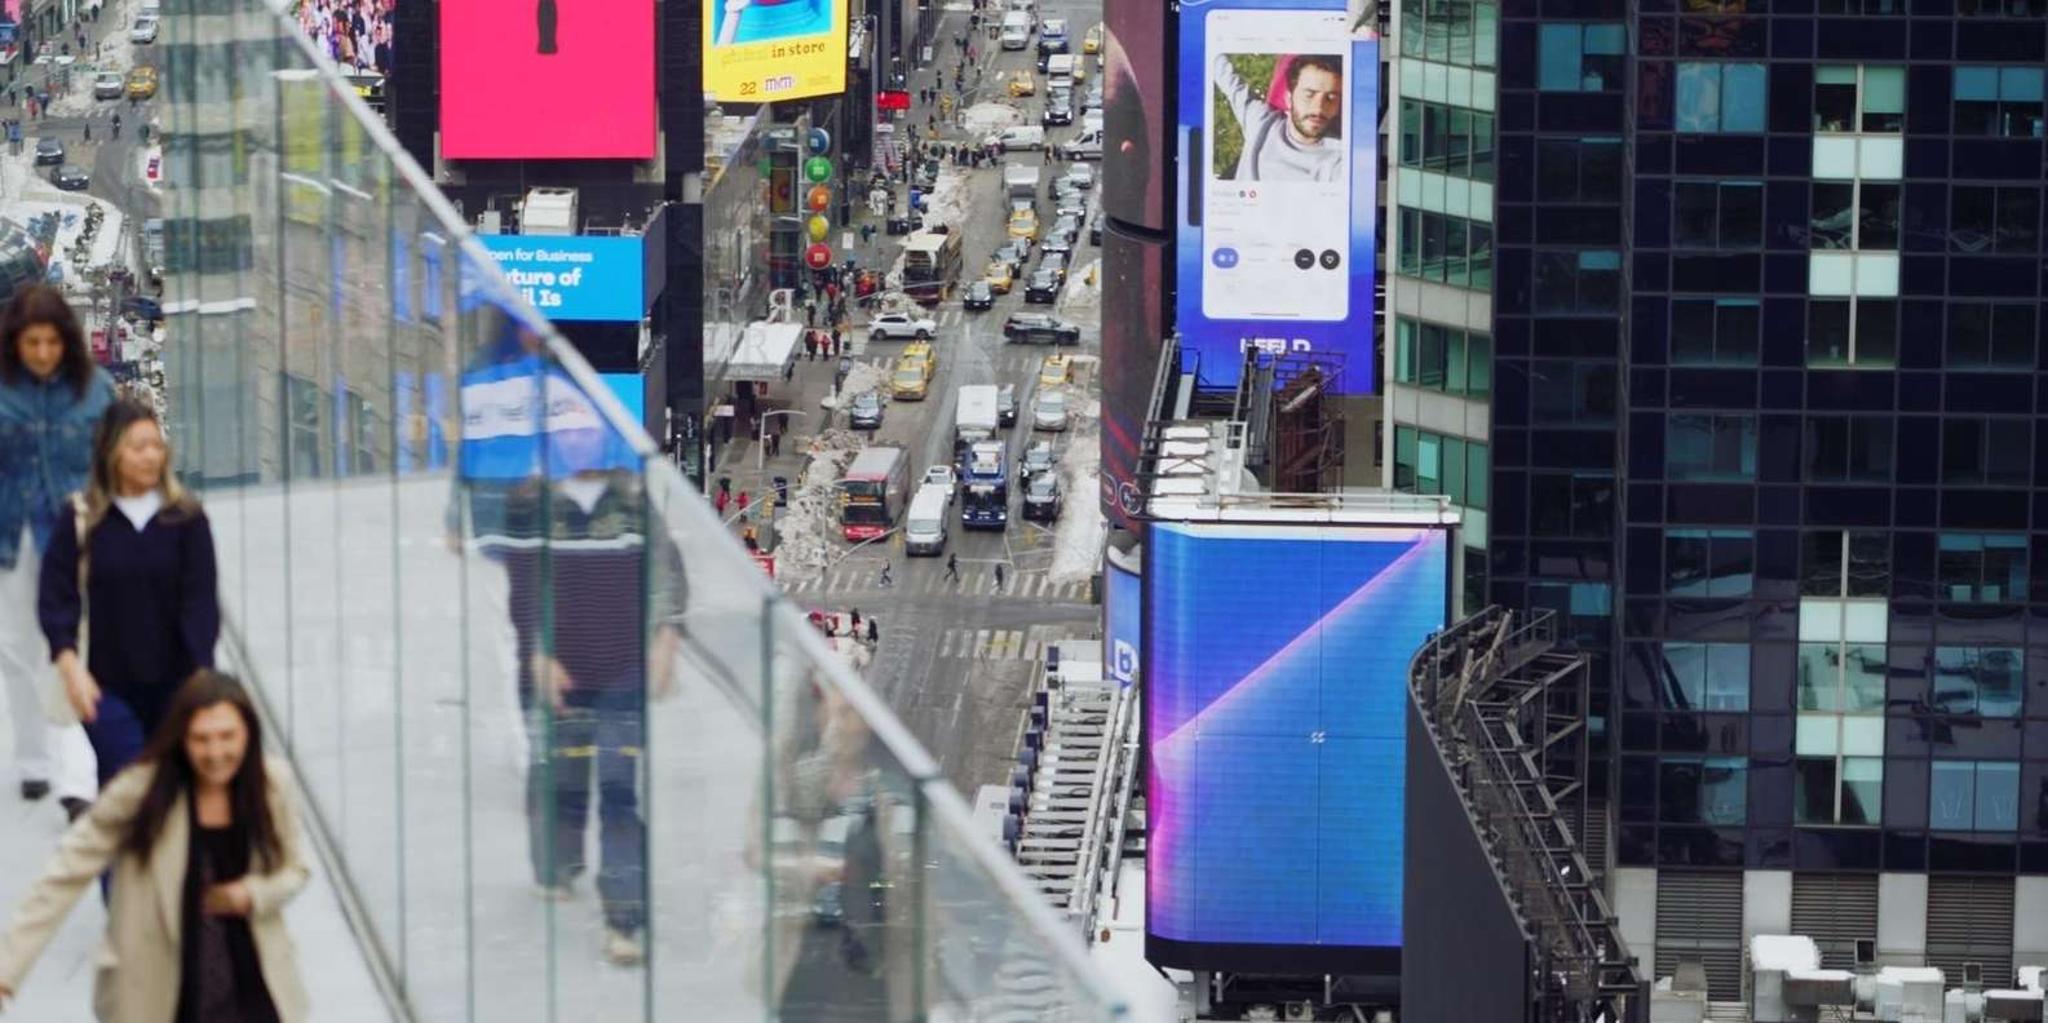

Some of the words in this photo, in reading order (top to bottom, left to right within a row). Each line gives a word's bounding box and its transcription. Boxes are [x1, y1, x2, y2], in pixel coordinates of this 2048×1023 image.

[771, 44, 785, 58] in
[740, 81, 757, 96] 22
[515, 247, 534, 262] for
[536, 249, 593, 263] Business
[559, 267, 582, 286] of
[538, 289, 563, 307] Is
